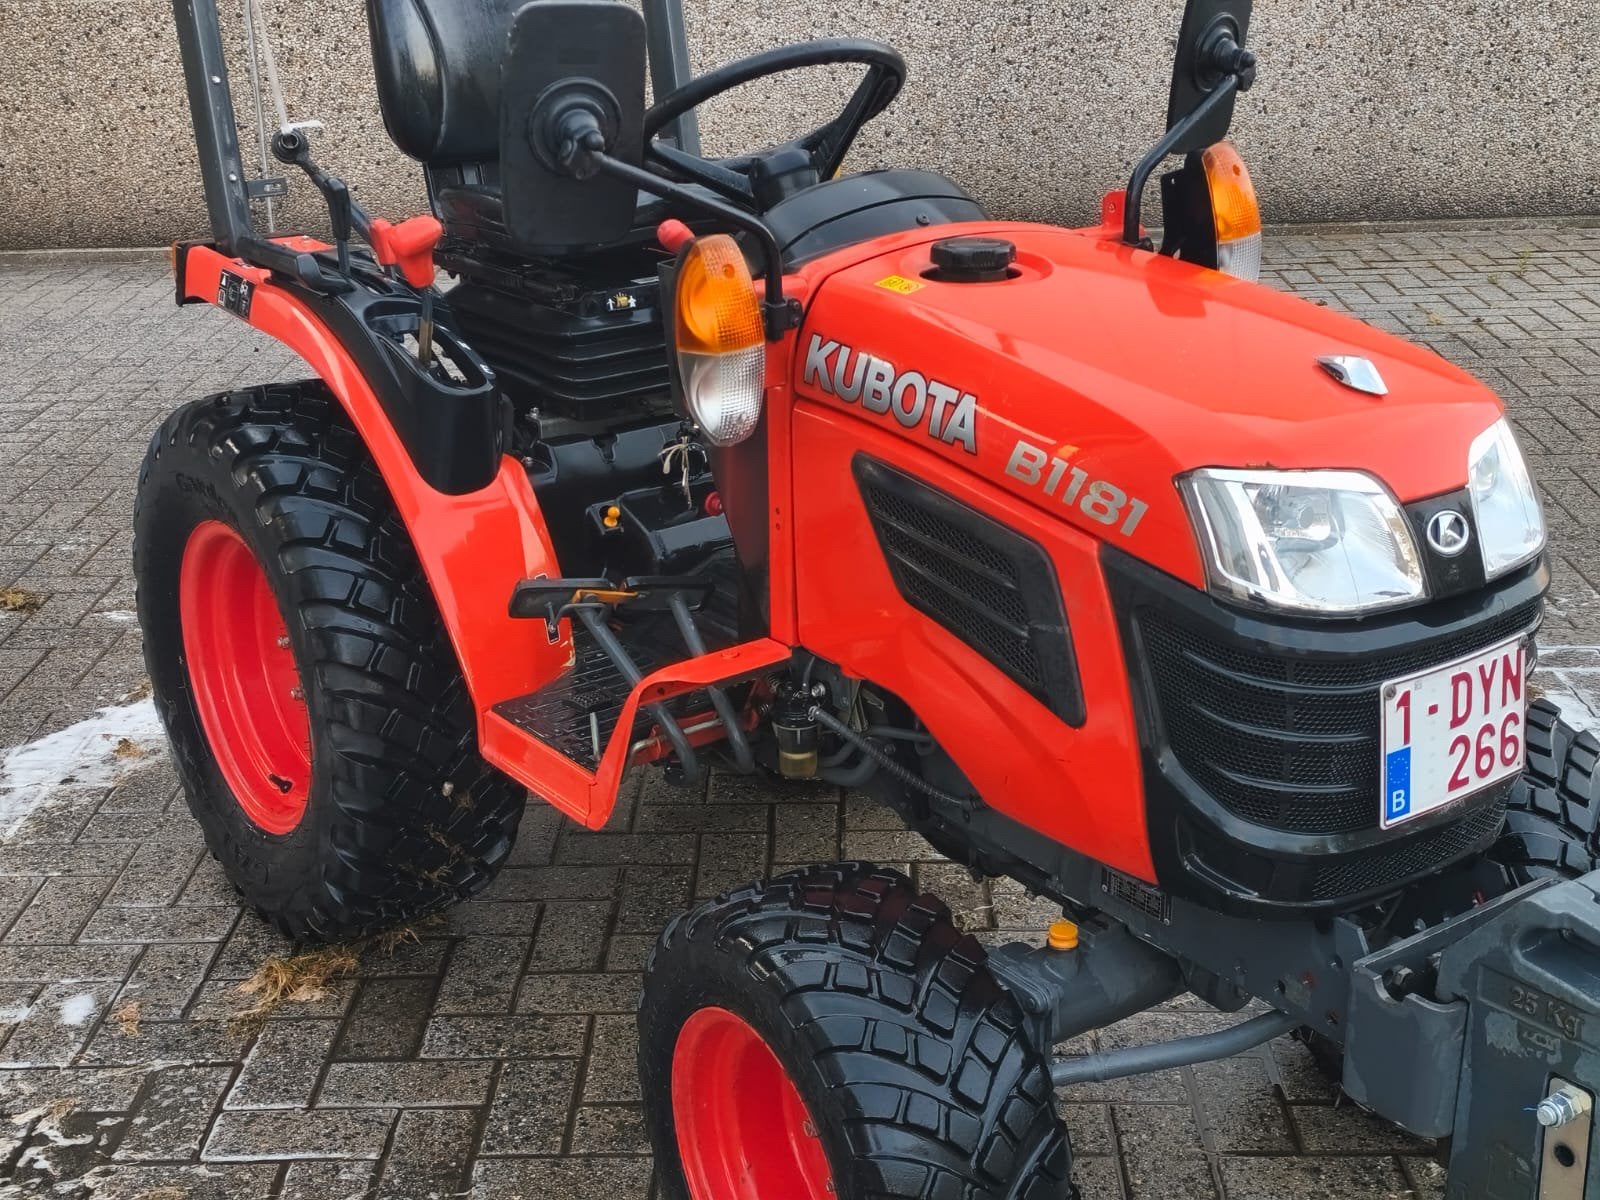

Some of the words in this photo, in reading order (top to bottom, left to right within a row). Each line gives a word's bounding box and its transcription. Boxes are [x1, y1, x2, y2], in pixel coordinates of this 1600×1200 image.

[804, 333, 978, 455] KUBOTA
[1005, 440, 1149, 536] B1181
[1448, 712, 1520, 792] 266
[1392, 790, 1405, 812] B
[1511, 985, 1538, 1015] 25
